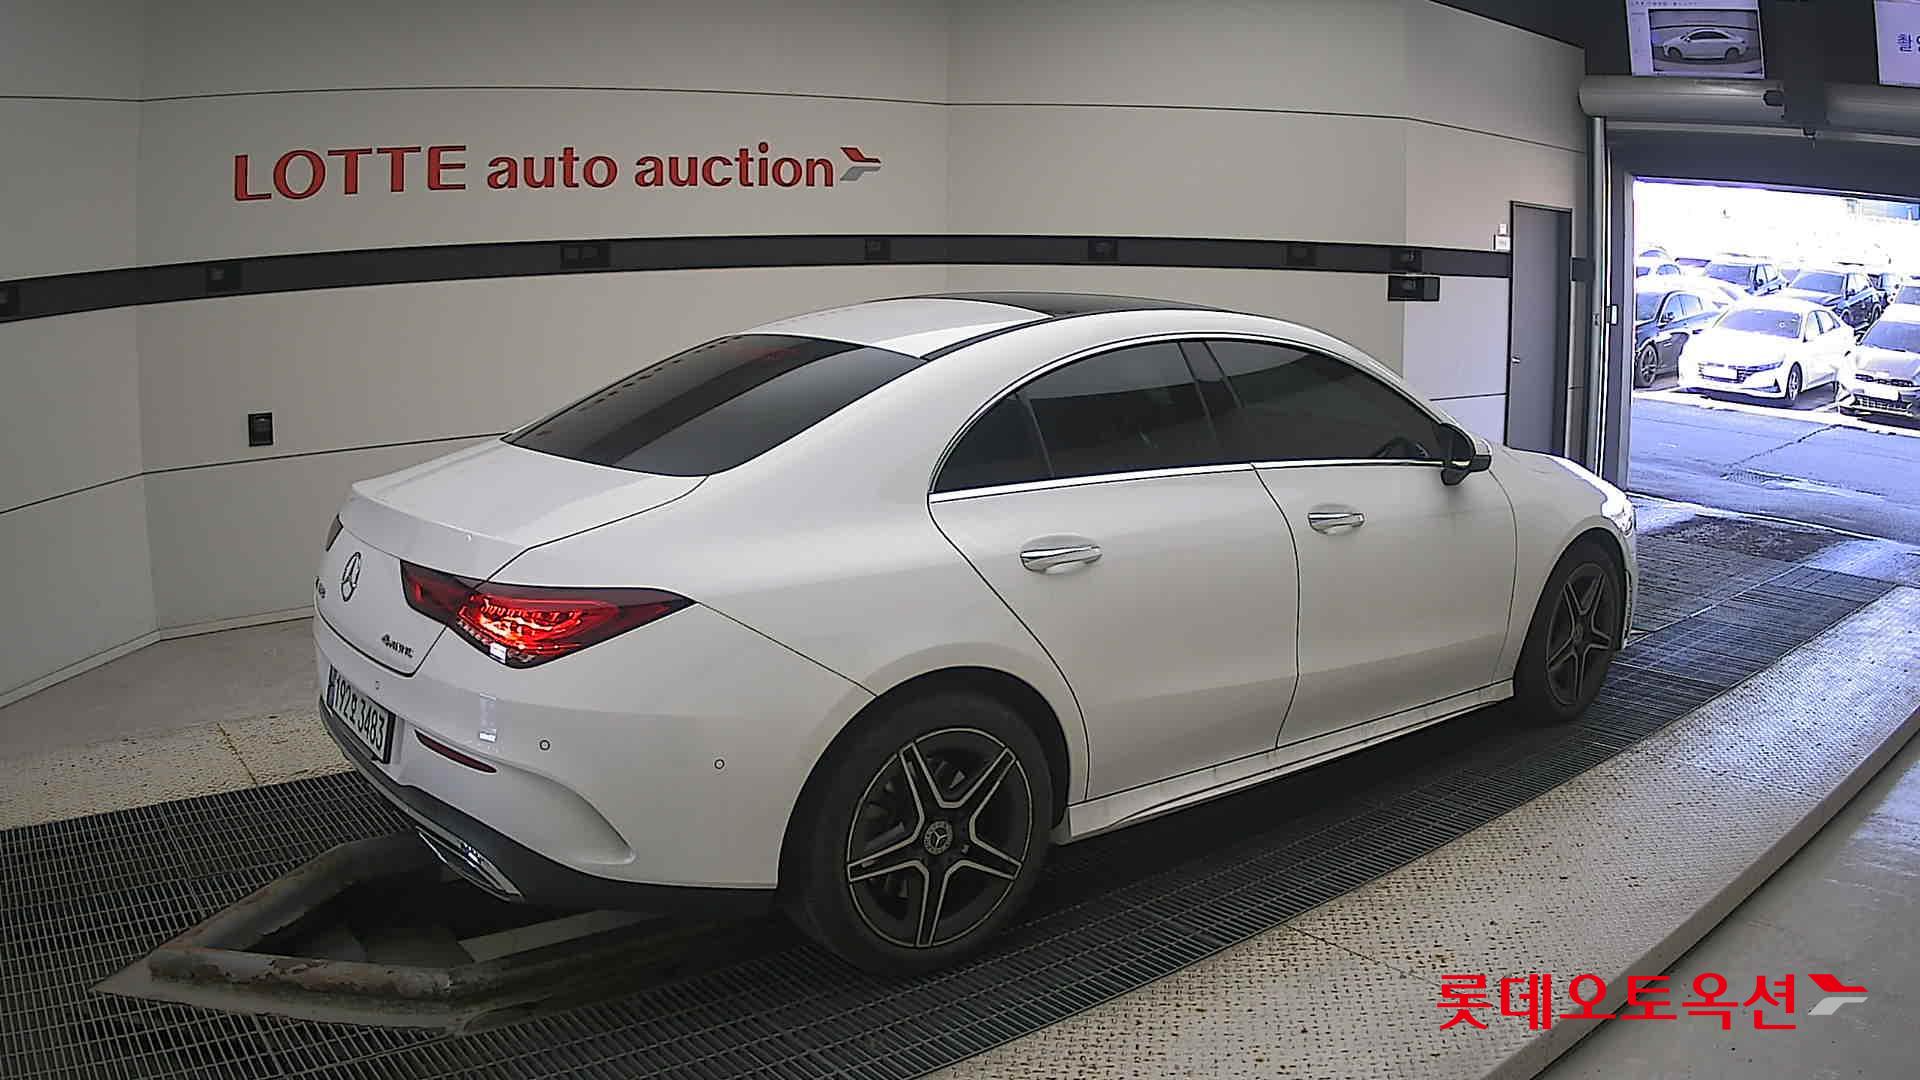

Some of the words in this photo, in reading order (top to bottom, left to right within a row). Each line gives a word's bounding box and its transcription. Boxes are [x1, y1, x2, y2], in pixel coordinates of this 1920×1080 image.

[234, 145, 467, 201] LOTTE
[487, 146, 618, 188] auto
[634, 142, 835, 187] auction
[358, 698, 385, 751] 3483
